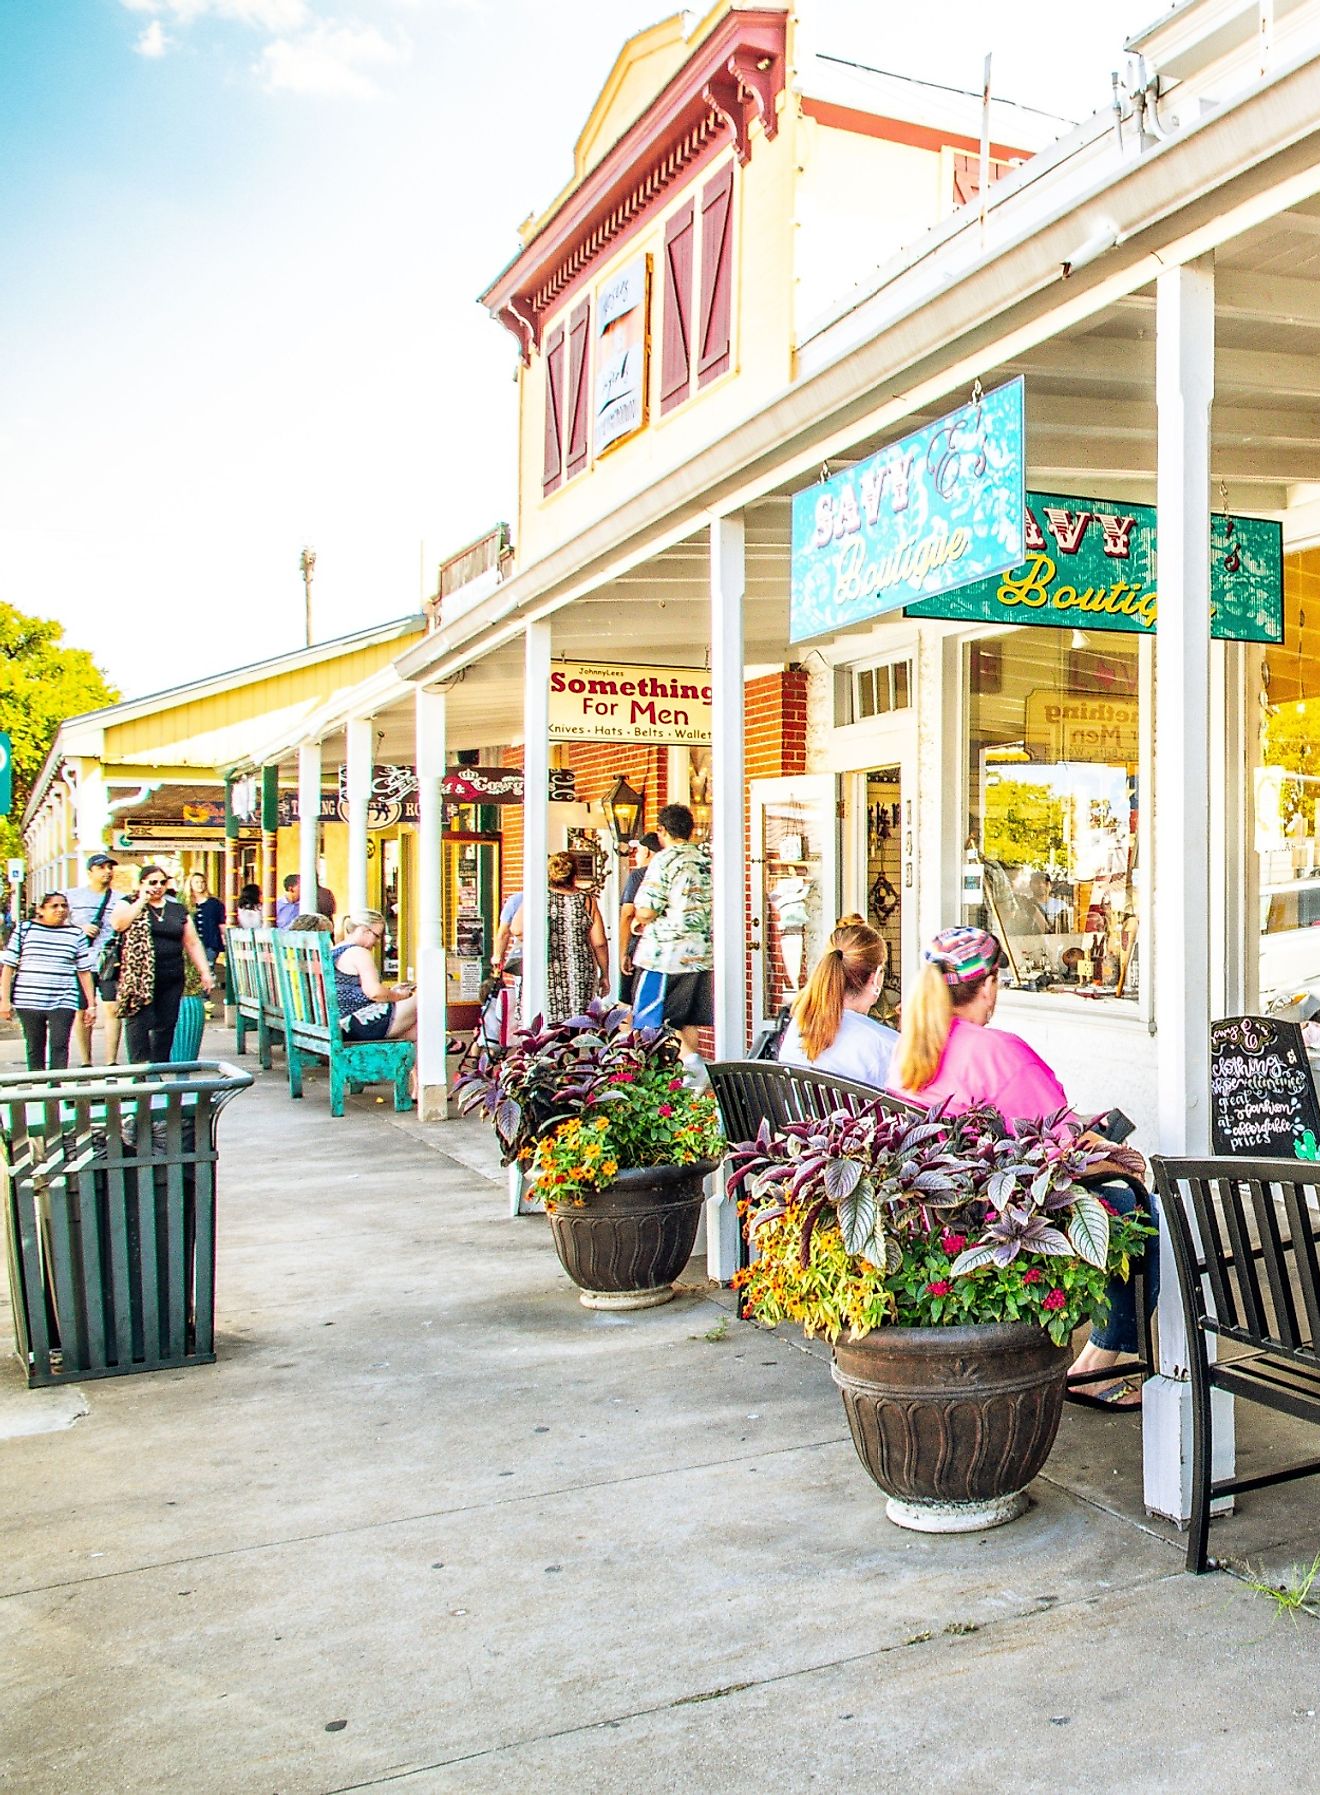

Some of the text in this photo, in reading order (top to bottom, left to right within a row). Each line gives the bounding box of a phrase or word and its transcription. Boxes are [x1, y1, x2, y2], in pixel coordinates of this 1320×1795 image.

[814, 453, 914, 549] SAVY
[1026, 505, 1137, 560] AVY
[832, 527, 969, 605] Boutique
[583, 697, 689, 726] For Men
[595, 725, 623, 736] Hats
[634, 726, 664, 738] Belts
[1230, 1133, 1271, 1152] prices
